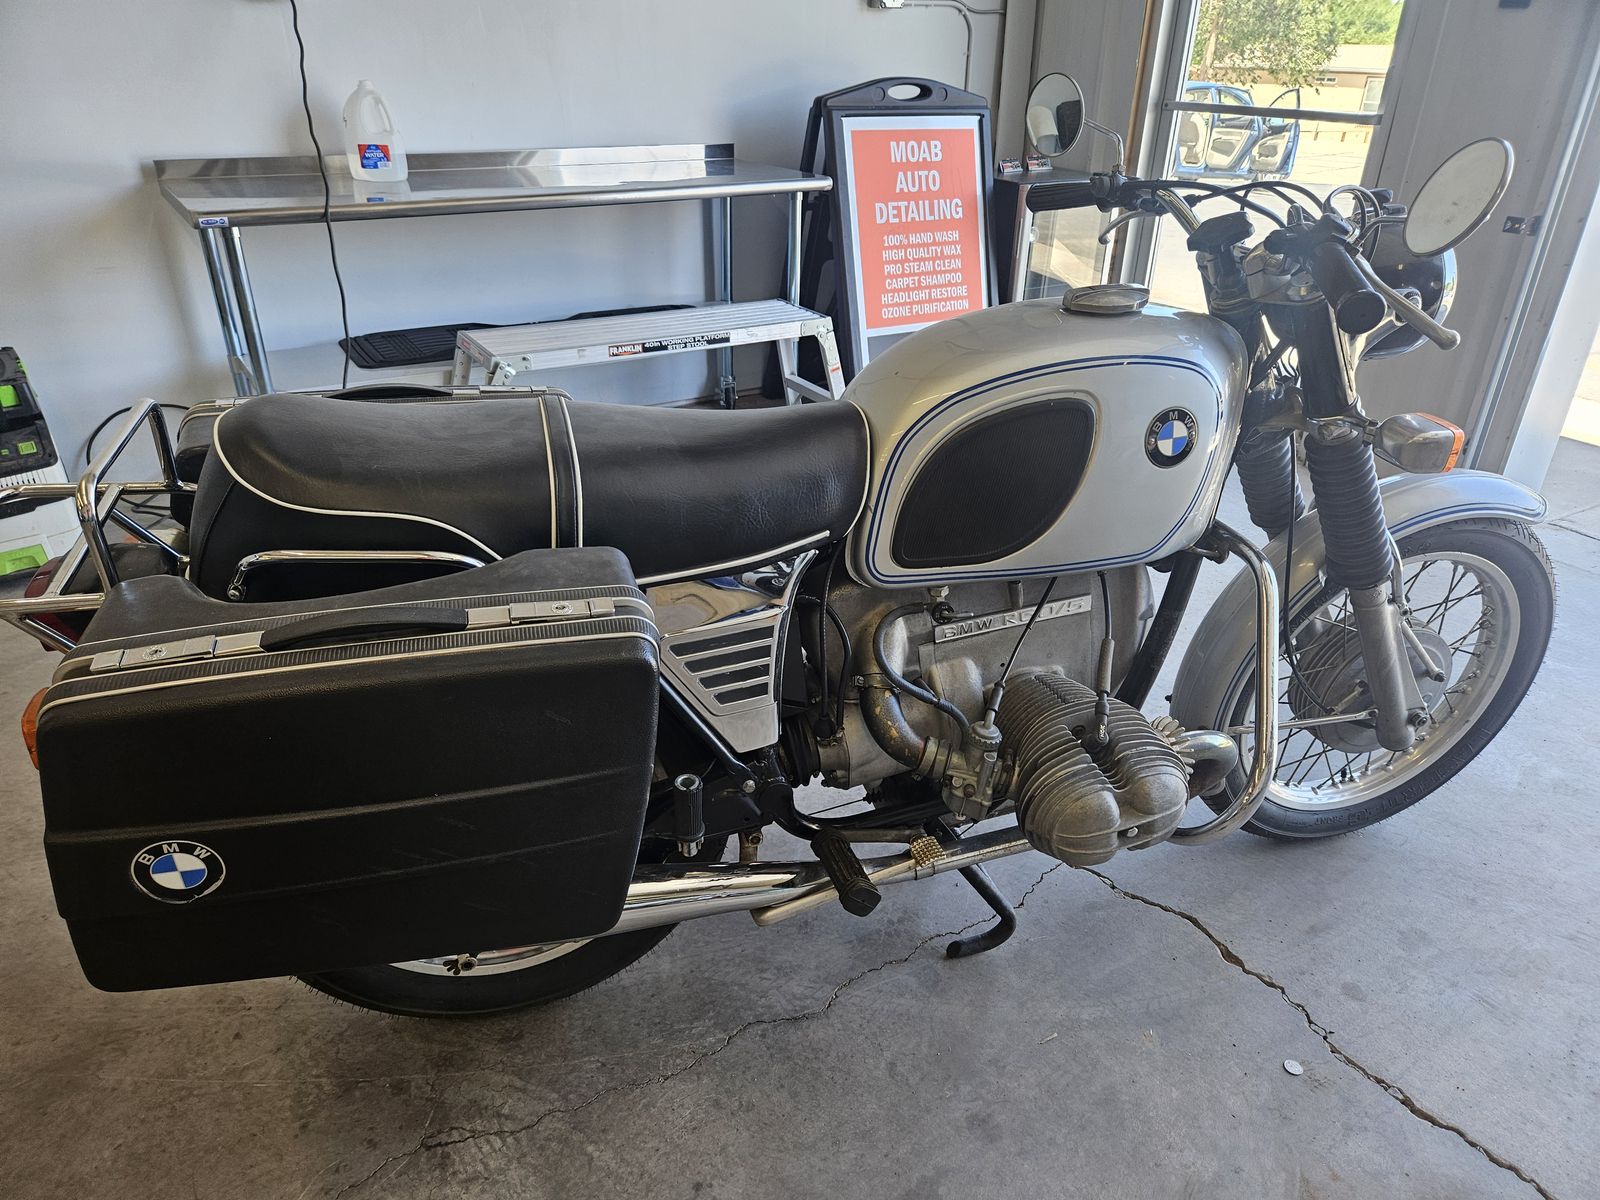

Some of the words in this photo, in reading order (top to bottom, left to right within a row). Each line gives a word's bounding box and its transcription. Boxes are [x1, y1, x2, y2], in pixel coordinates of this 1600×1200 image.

[889, 140, 943, 163] MOAB
[895, 169, 941, 193] AUTO
[875, 198, 963, 224] DETAILING
[883, 234, 908, 247] 100%
[909, 232, 933, 244] HAND
[935, 230, 959, 242] WASH
[882, 248, 905, 262] HIGH
[907, 245, 942, 261] QUALITY
[943, 244, 962, 256] WAX
[884, 263, 902, 276] PRO
[904, 261, 933, 274] STEAM
[935, 258, 962, 271] CLEAN
[885, 276, 919, 290] CARPET
[920, 272, 962, 287] SHAMPOO
[881, 289, 930, 305] HEADLIGHT
[931, 285, 968, 299] RESTORE
[882, 306, 911, 319] OZONE
[912, 299, 969, 315] PURIFICATION
[661, 337, 695, 346] WORKING
[695, 331, 730, 342] PLATFORM
[686, 340, 709, 348] STOOL
[609, 344, 642, 356] FRANKLIN
[1152, 410, 1194, 432] BMW
[943, 617, 993, 639] BMW
[137, 842, 212, 866] BMW
